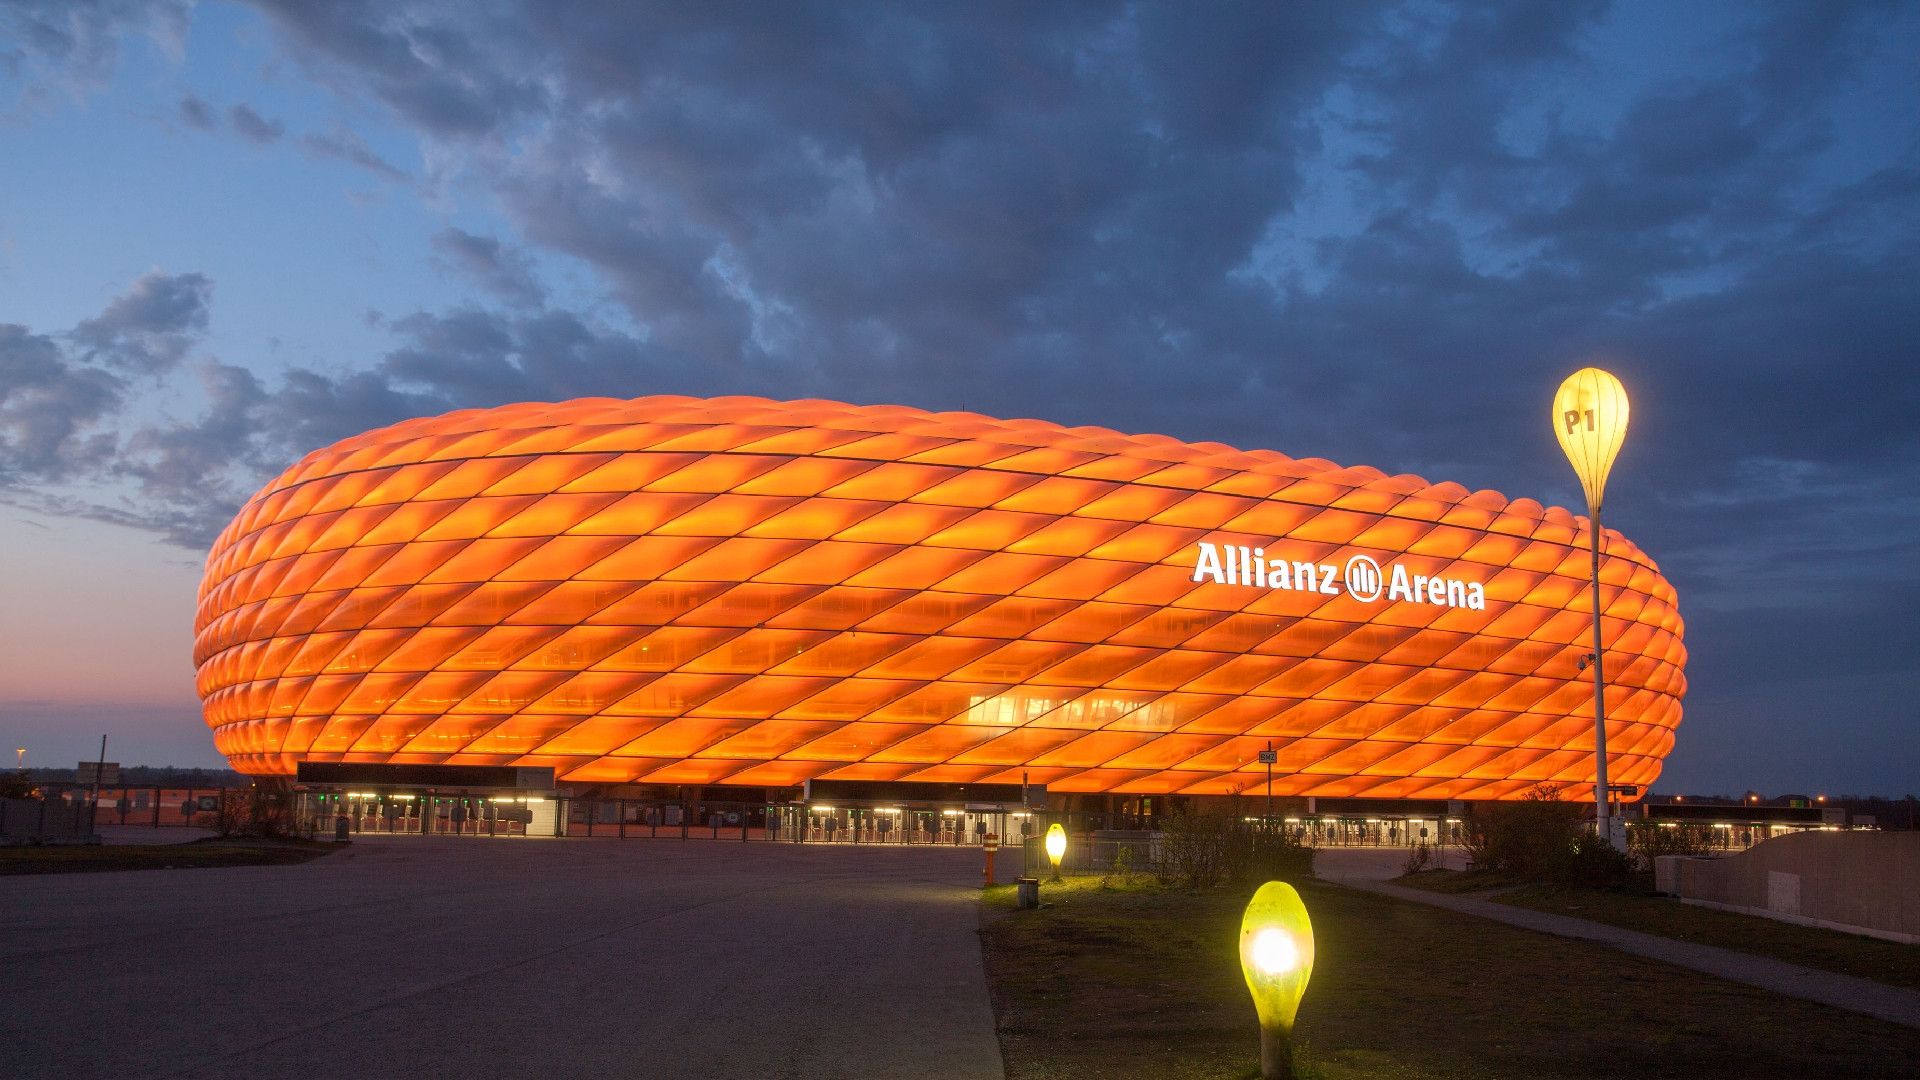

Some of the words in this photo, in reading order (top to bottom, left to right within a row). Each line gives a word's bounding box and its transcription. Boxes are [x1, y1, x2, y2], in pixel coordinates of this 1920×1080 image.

[1564, 409, 1595, 435] P1
[1193, 542, 1339, 595] Allianz
[1388, 564, 1486, 610] Arena
